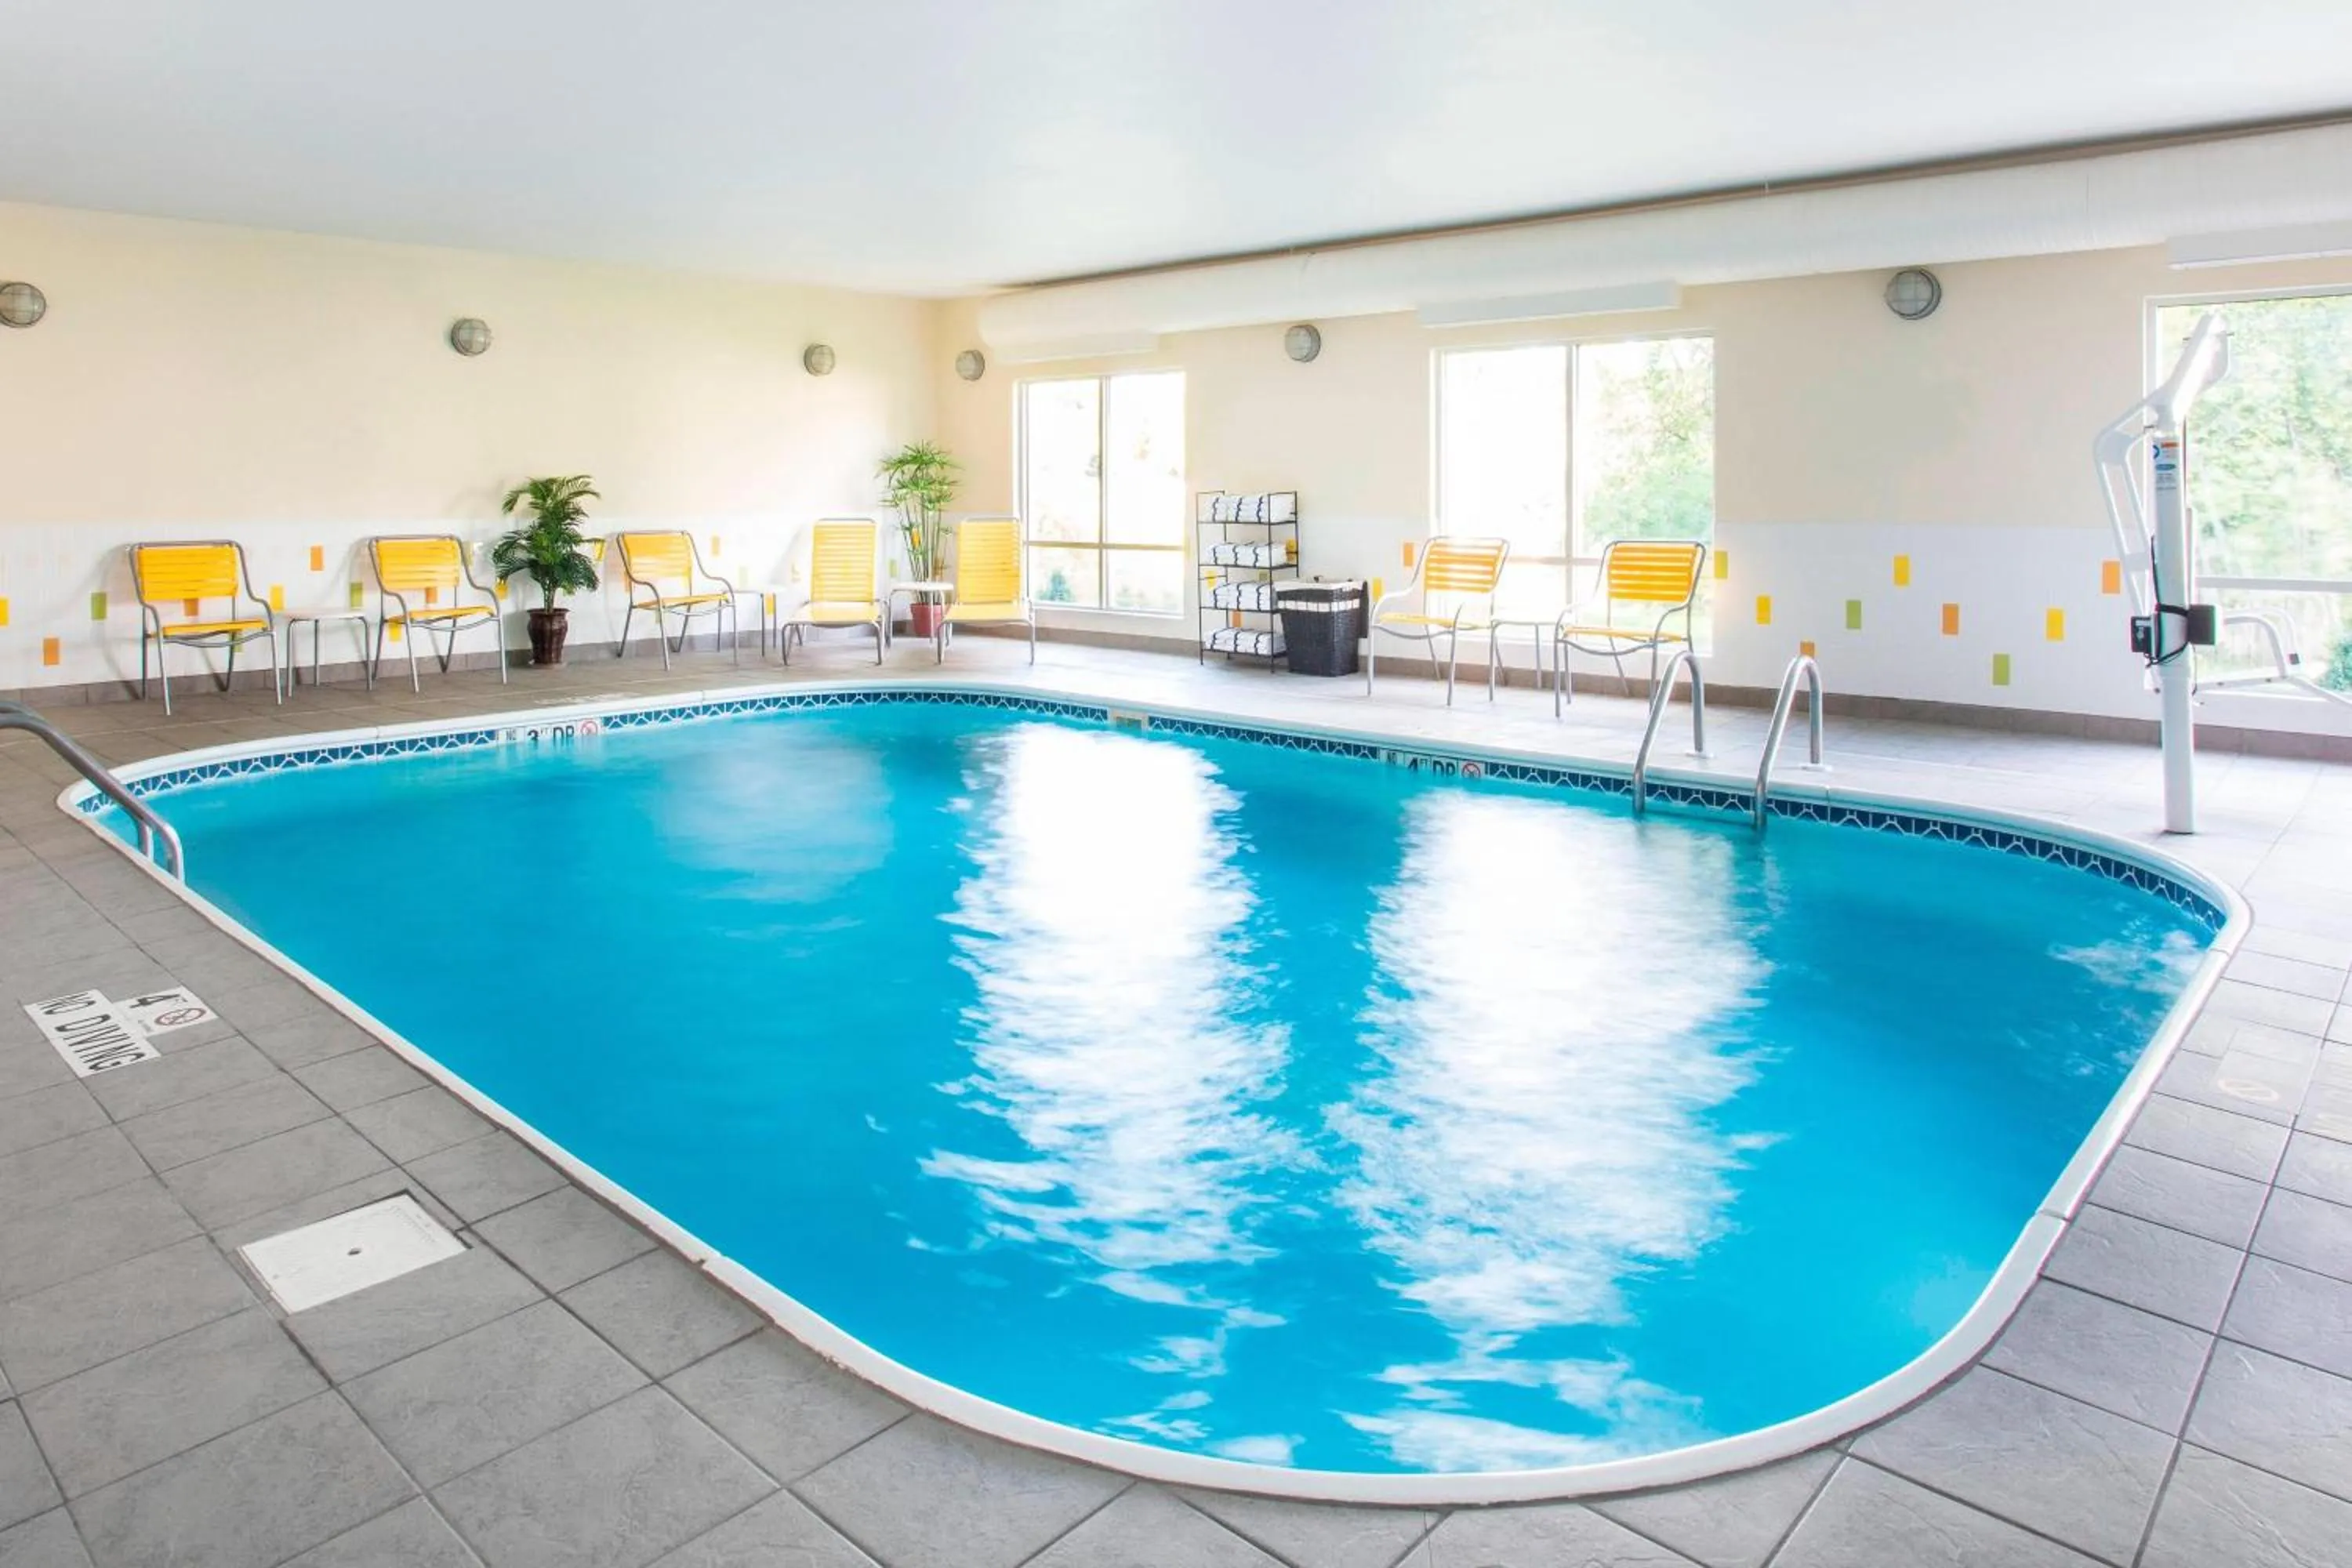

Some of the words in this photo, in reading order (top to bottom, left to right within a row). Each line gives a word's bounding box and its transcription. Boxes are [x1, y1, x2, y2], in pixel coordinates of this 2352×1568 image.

[37, 991, 96, 1015] NO
[129, 993, 181, 1009] 4
[55, 1014, 147, 1071] DIVING
